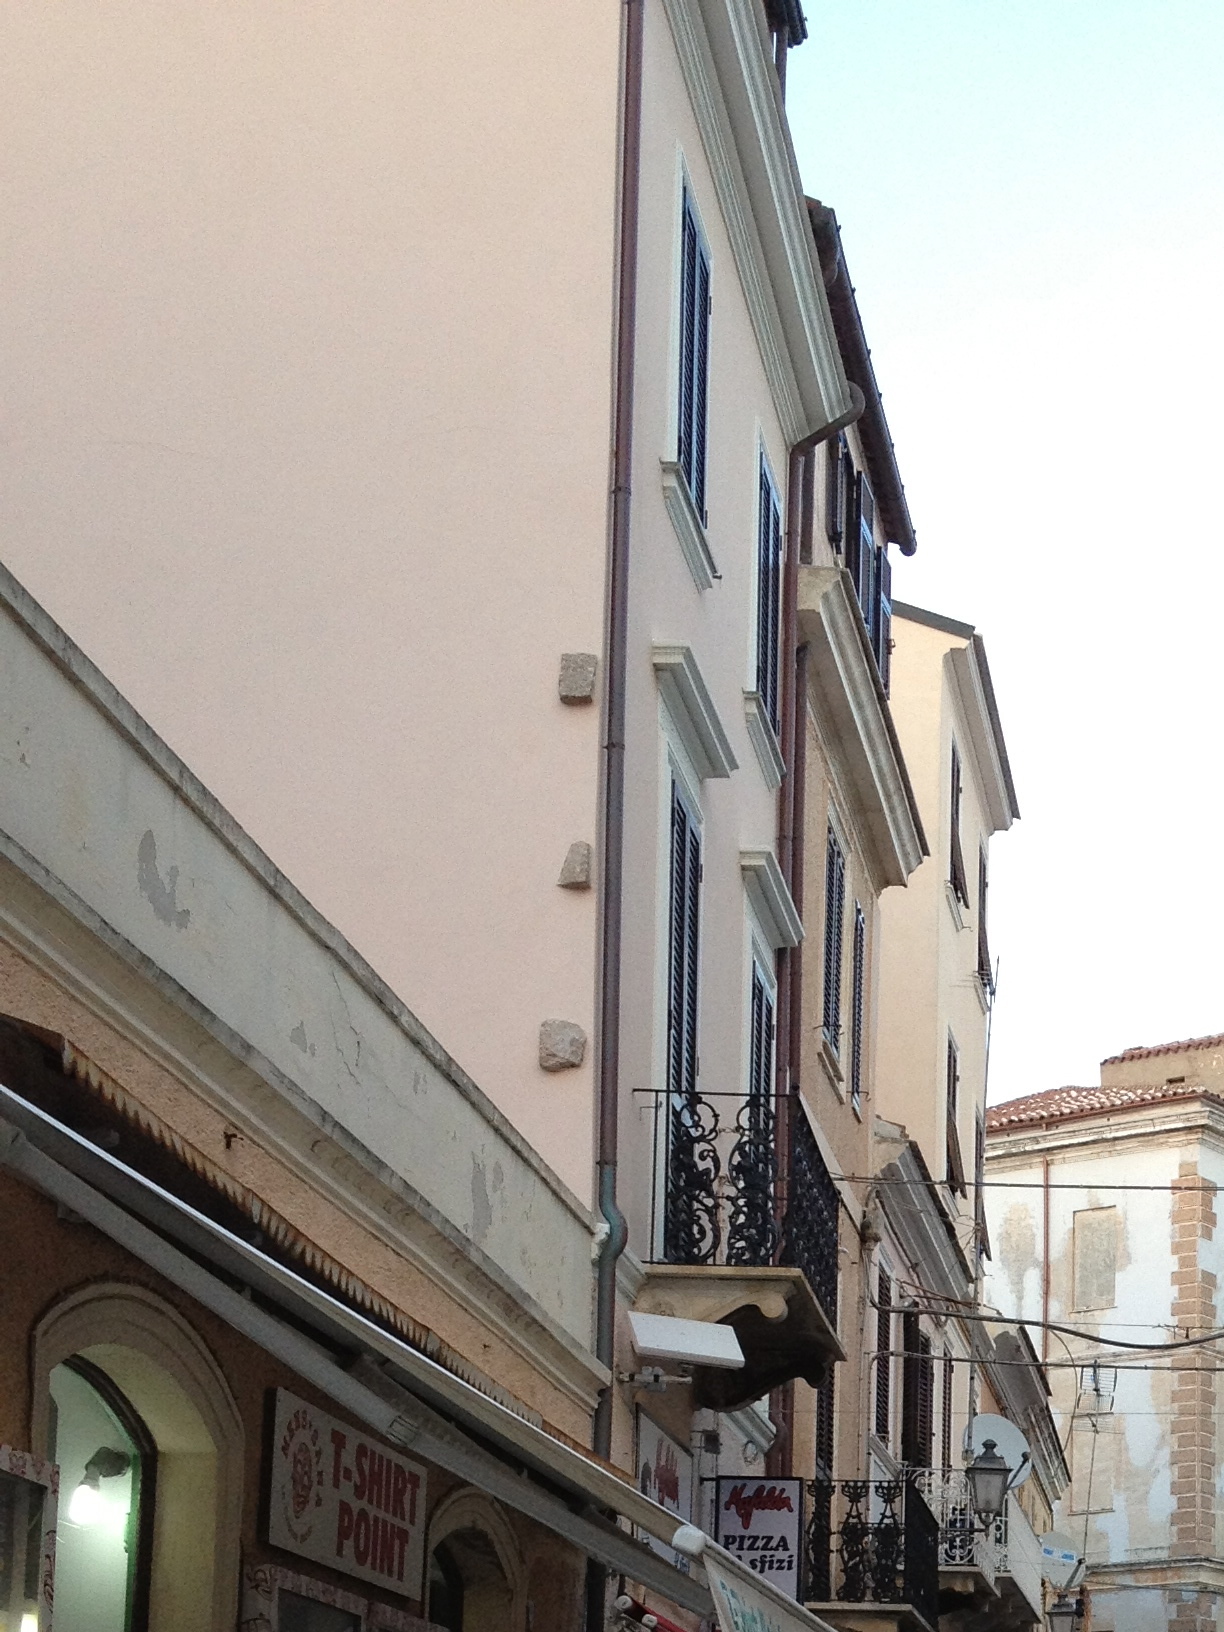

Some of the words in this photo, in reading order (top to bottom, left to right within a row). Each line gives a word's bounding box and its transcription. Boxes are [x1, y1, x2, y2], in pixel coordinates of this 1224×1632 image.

[331, 1427, 421, 1526] T-SHIRT
[335, 1499, 410, 1583] POINT
[723, 1534, 790, 1553] PIZZA
[748, 1553, 795, 1574] sfizi
